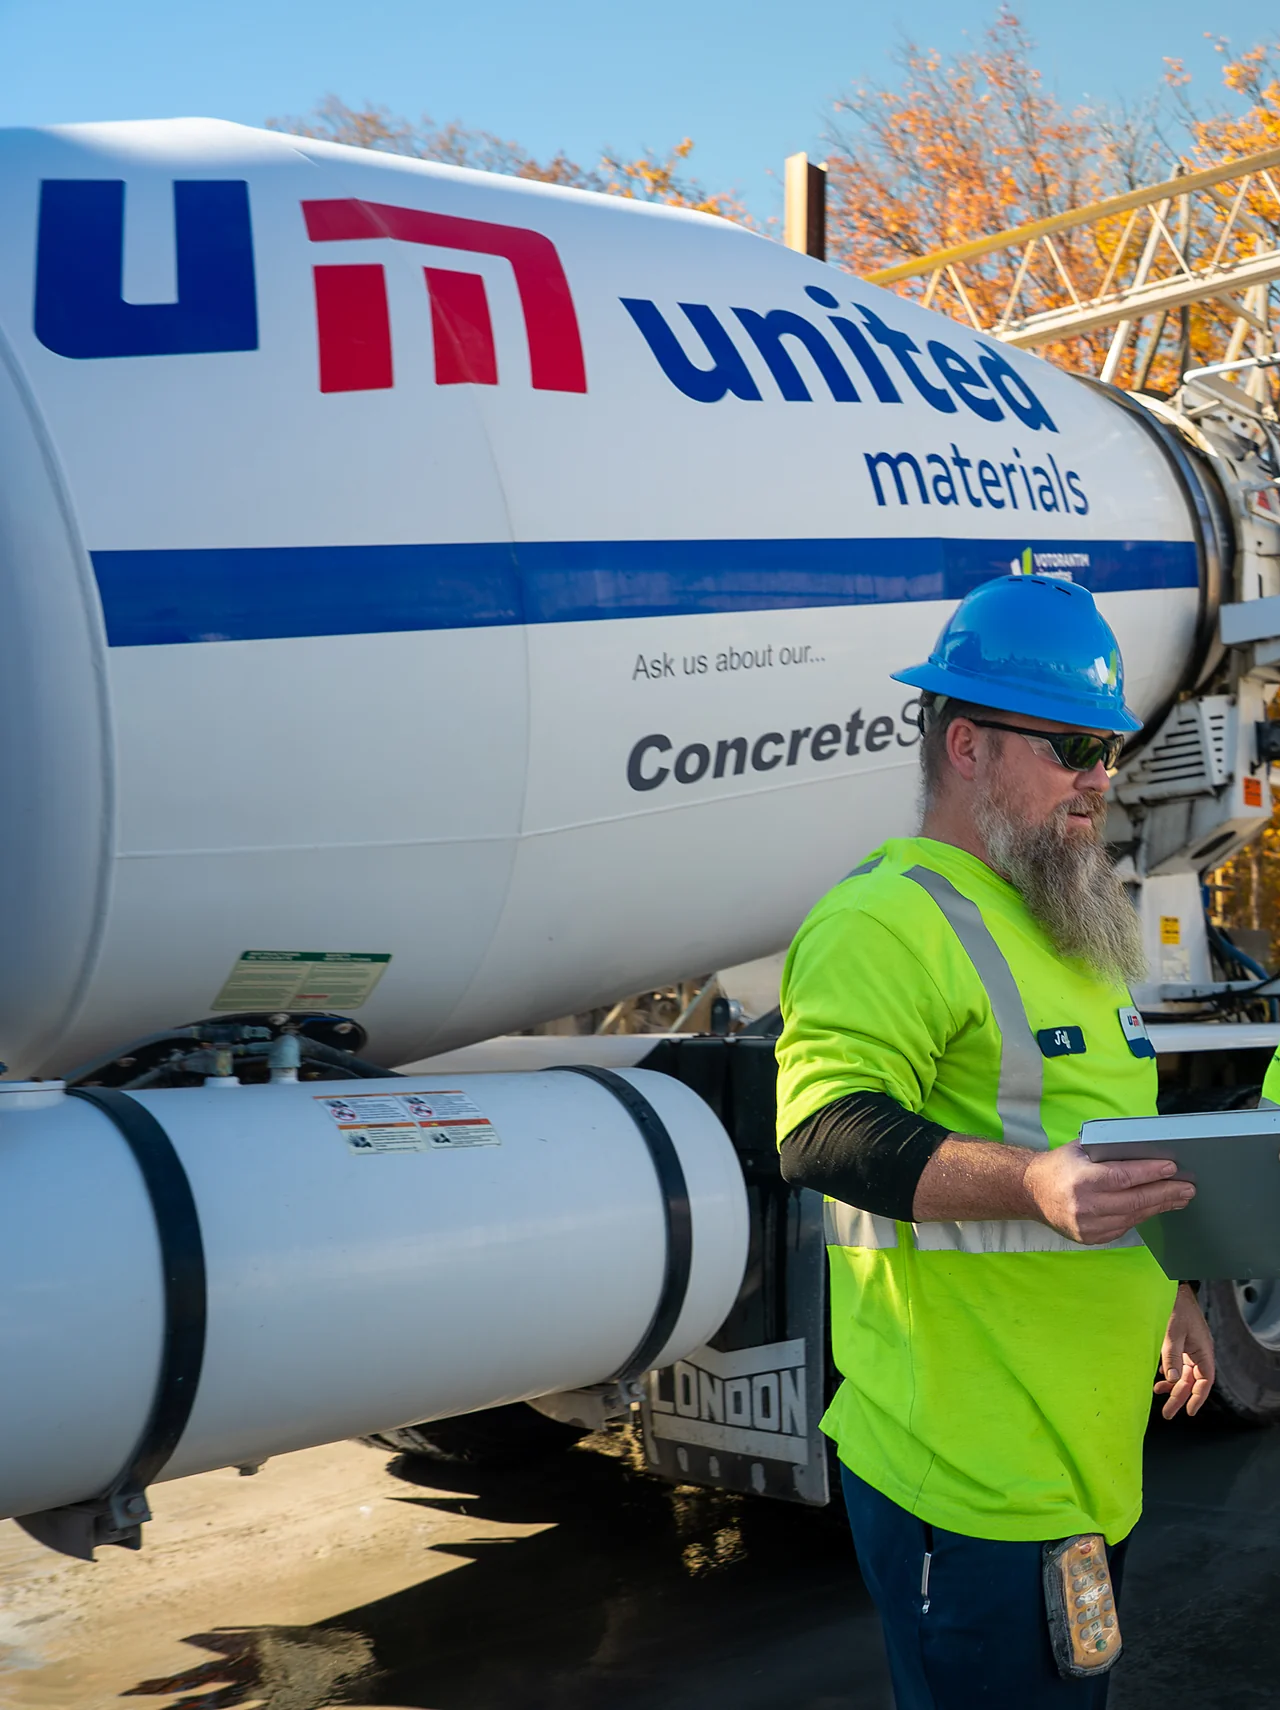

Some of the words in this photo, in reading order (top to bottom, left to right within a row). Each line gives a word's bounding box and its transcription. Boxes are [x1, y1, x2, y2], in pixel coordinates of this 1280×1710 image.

[619, 285, 1060, 434] united
[863, 443, 1090, 517] materials
[632, 652, 676, 681] Ask
[682, 654, 709, 676] us
[715, 644, 774, 673] about
[651, 1360, 808, 1438] LONDON
